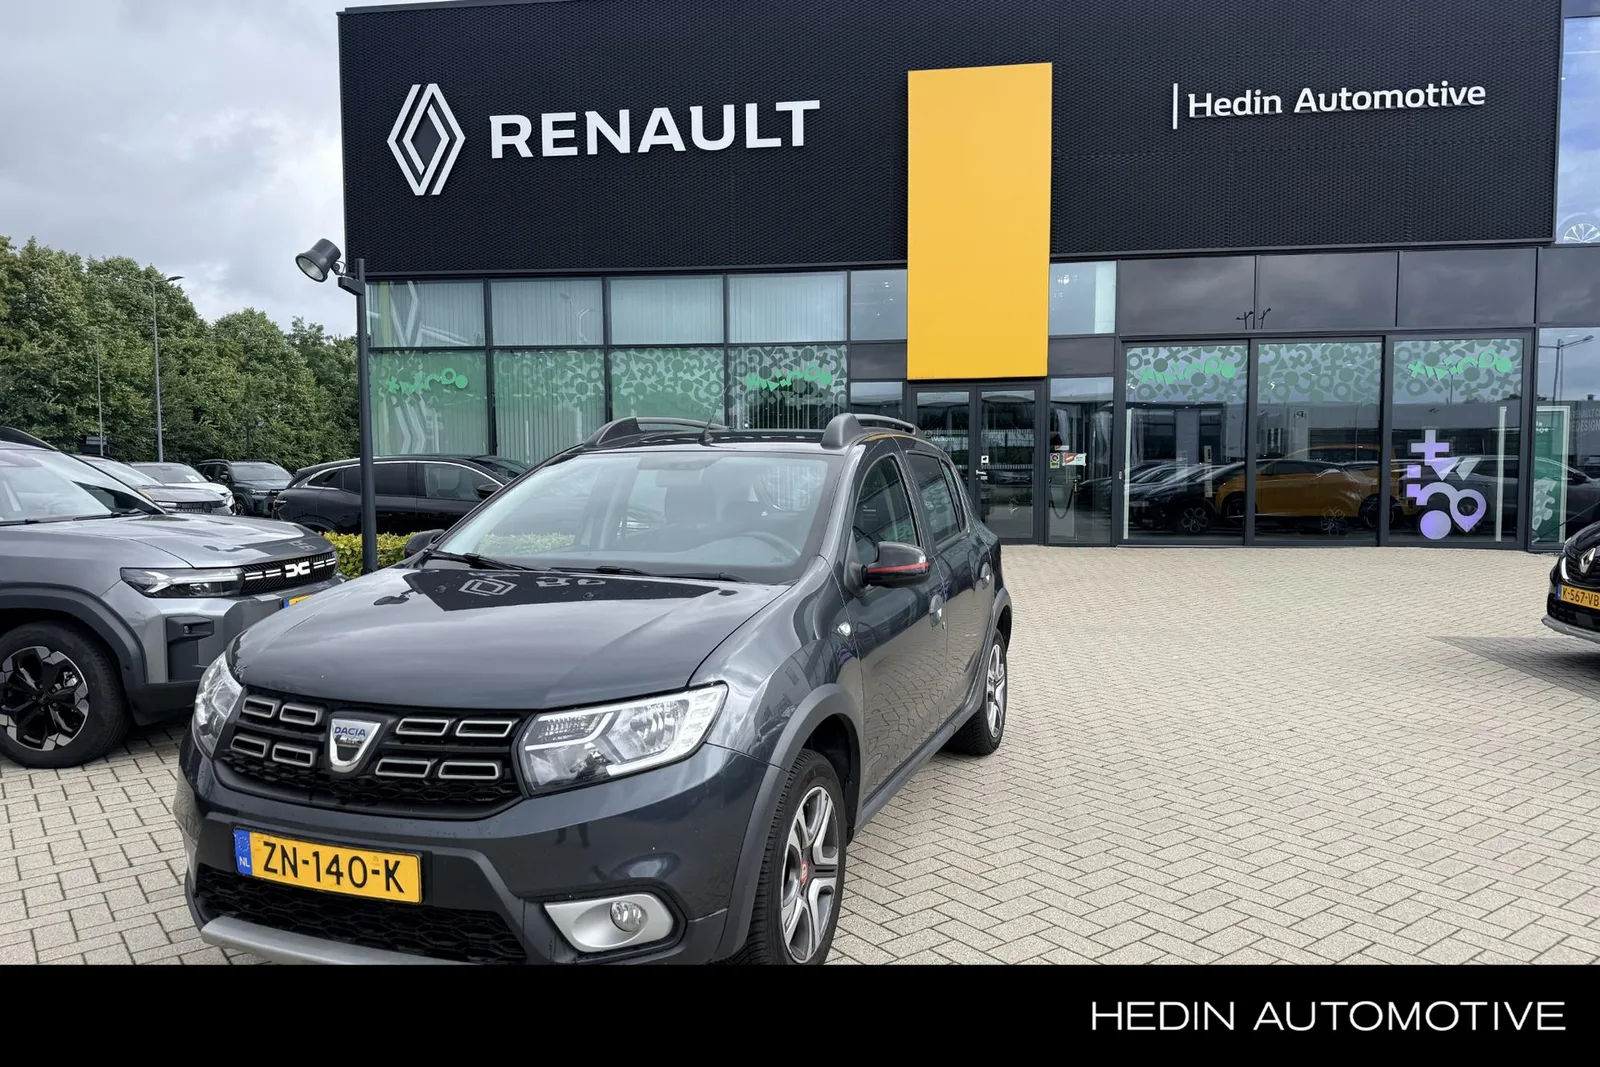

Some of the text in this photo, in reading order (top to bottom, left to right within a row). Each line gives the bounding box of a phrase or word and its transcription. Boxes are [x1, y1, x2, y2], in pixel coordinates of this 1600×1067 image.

[1188, 80, 1486, 118] Hedin Automotive
[489, 99, 821, 159] RENAULT
[1562, 587, 1600, 607] K-567-VB
[334, 726, 366, 737] DACIA
[240, 856, 250, 868] NL
[263, 841, 405, 893] ZN-140-K
